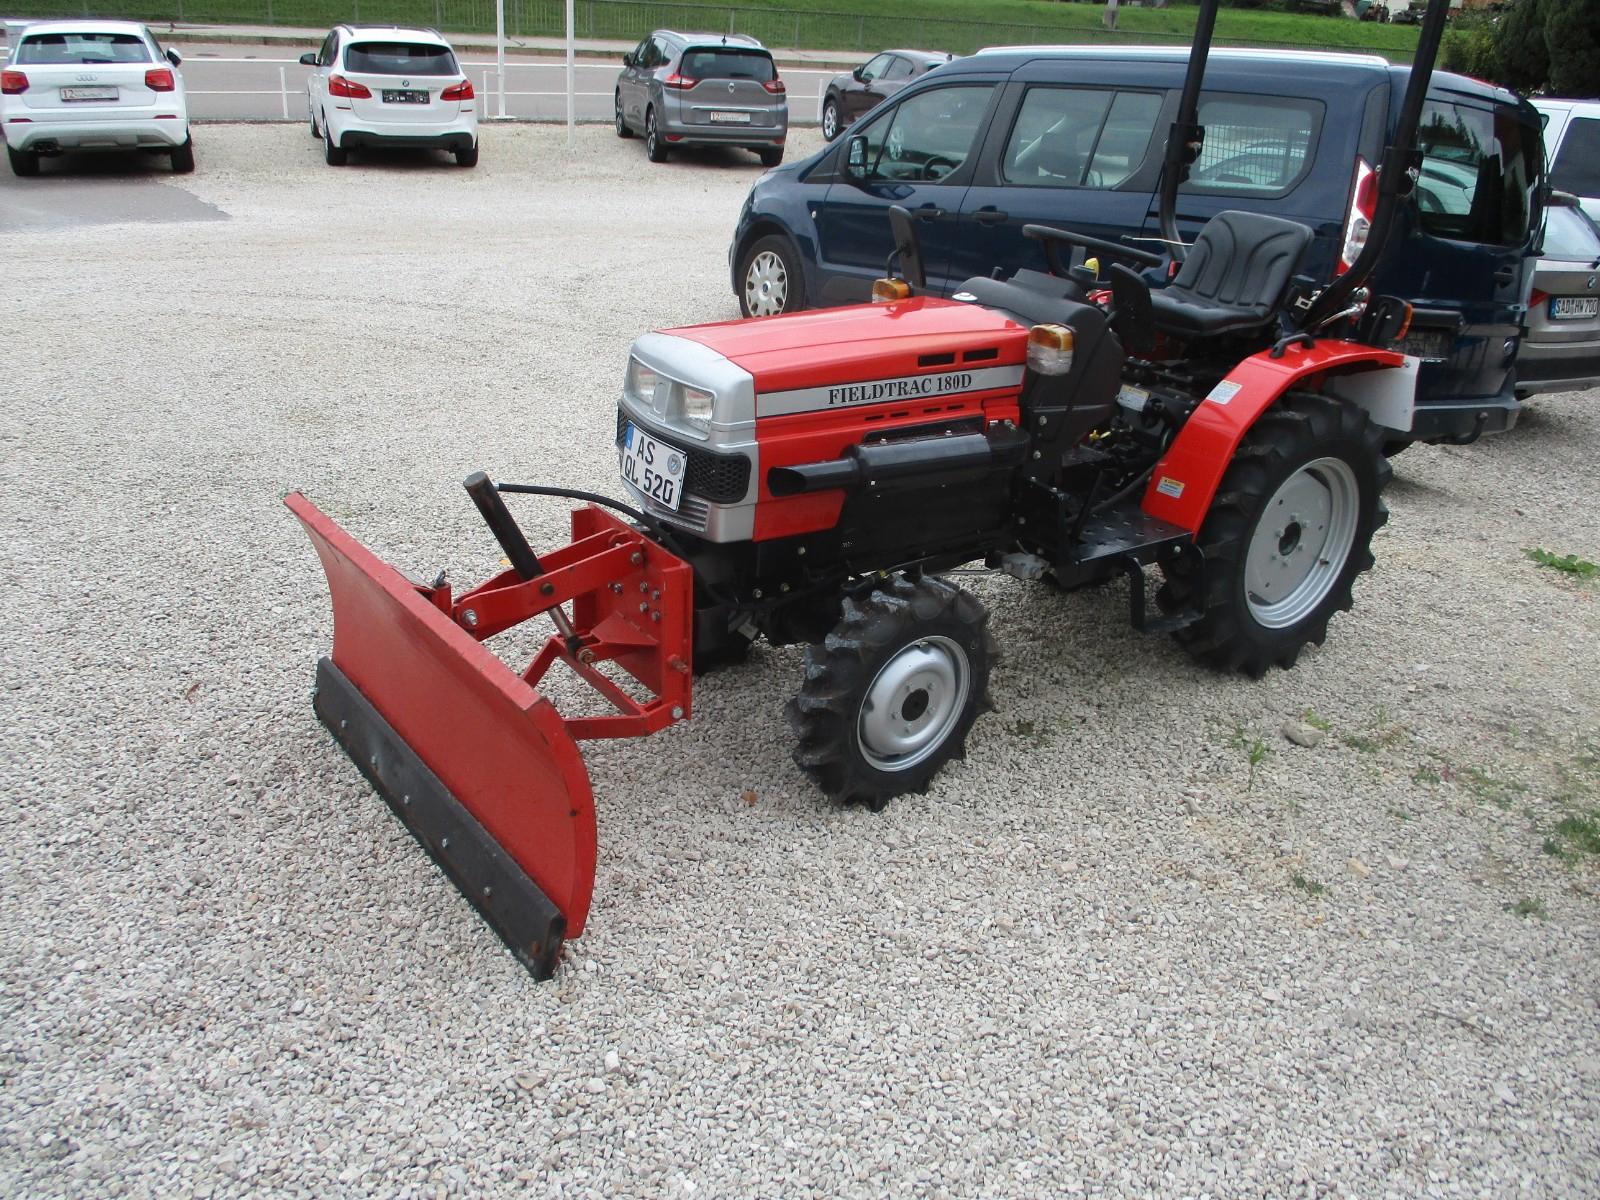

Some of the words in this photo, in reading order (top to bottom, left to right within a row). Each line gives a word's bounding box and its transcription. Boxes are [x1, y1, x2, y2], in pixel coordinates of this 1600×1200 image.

[828, 377, 932, 405] FIELDTRAC
[937, 373, 972, 392] 180D
[637, 435, 656, 466] AS
[624, 454, 639, 485] QL
[643, 467, 674, 505] 520
